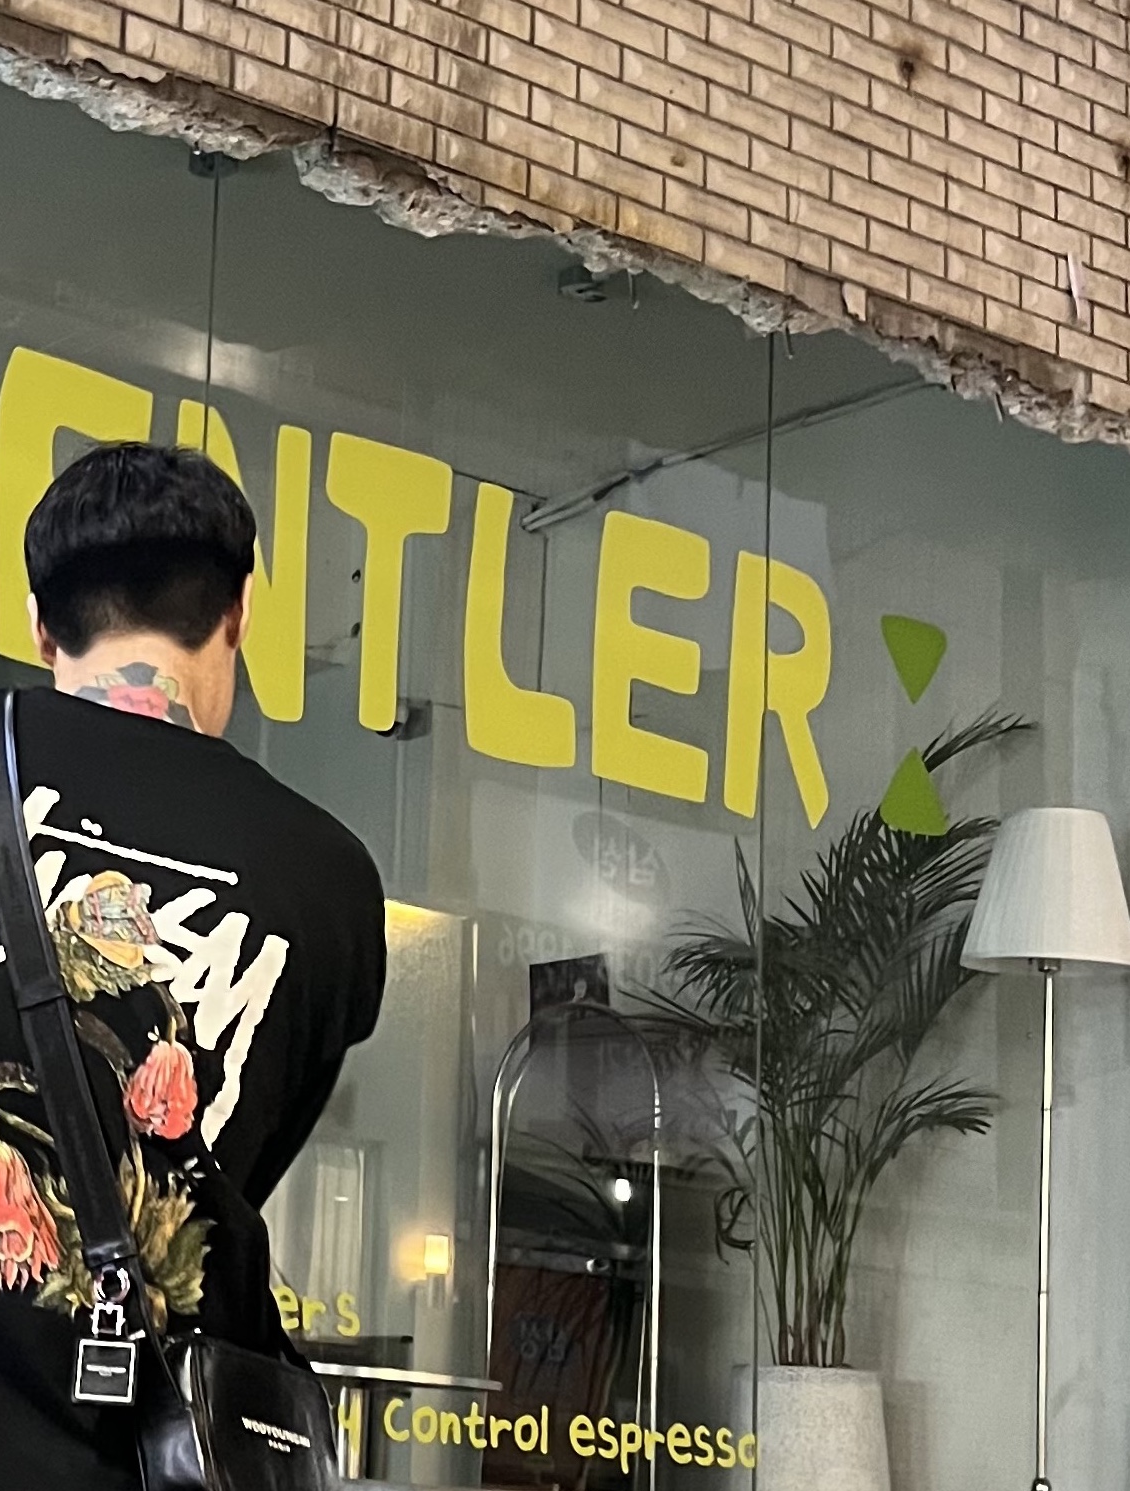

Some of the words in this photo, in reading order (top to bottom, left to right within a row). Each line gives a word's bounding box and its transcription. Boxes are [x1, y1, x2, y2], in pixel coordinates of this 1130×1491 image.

[273, 1286, 361, 1337] ers
[383, 1397, 549, 1455] Control
[569, 1414, 759, 1475] espresso
